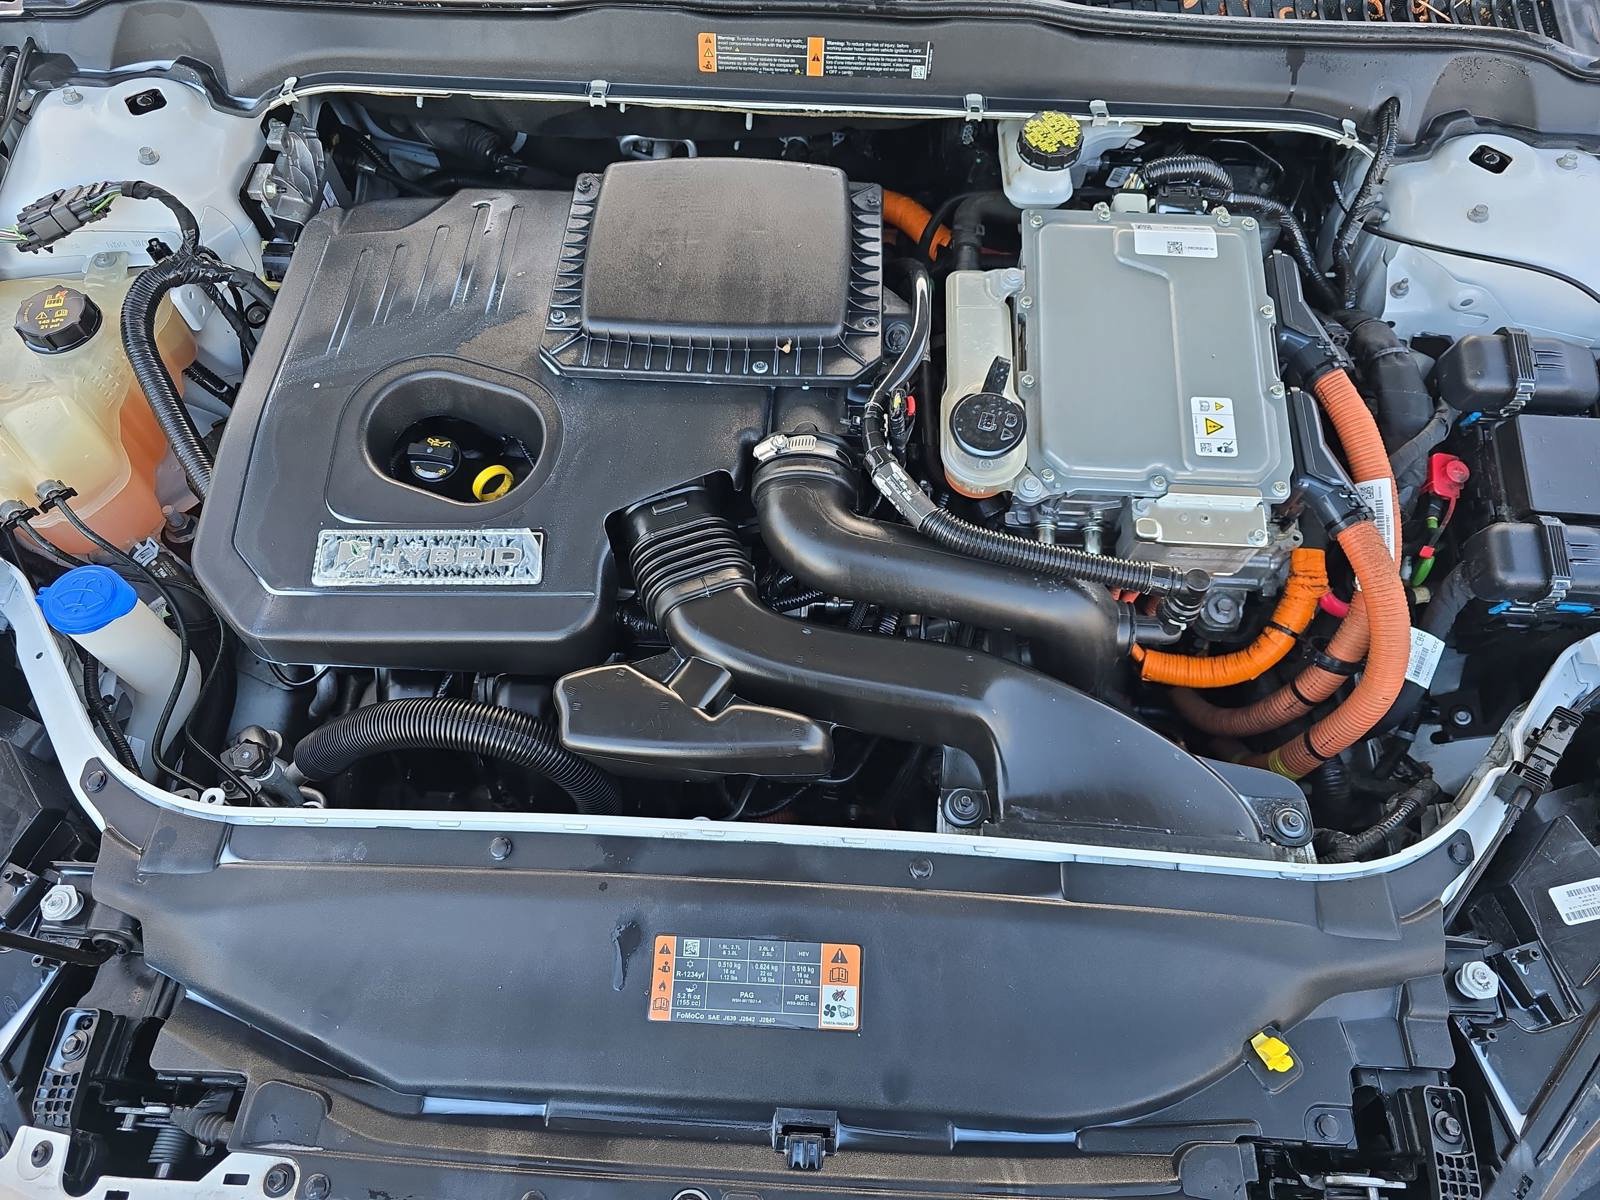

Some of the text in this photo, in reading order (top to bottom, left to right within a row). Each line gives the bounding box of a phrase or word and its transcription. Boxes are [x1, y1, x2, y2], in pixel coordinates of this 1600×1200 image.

[375, 546, 522, 567] HYBRID
[676, 970, 705, 980] R-1234yf
[739, 991, 755, 999] PAG
[794, 994, 810, 1002] POE
[676, 1011, 705, 1020] FoMoCo
